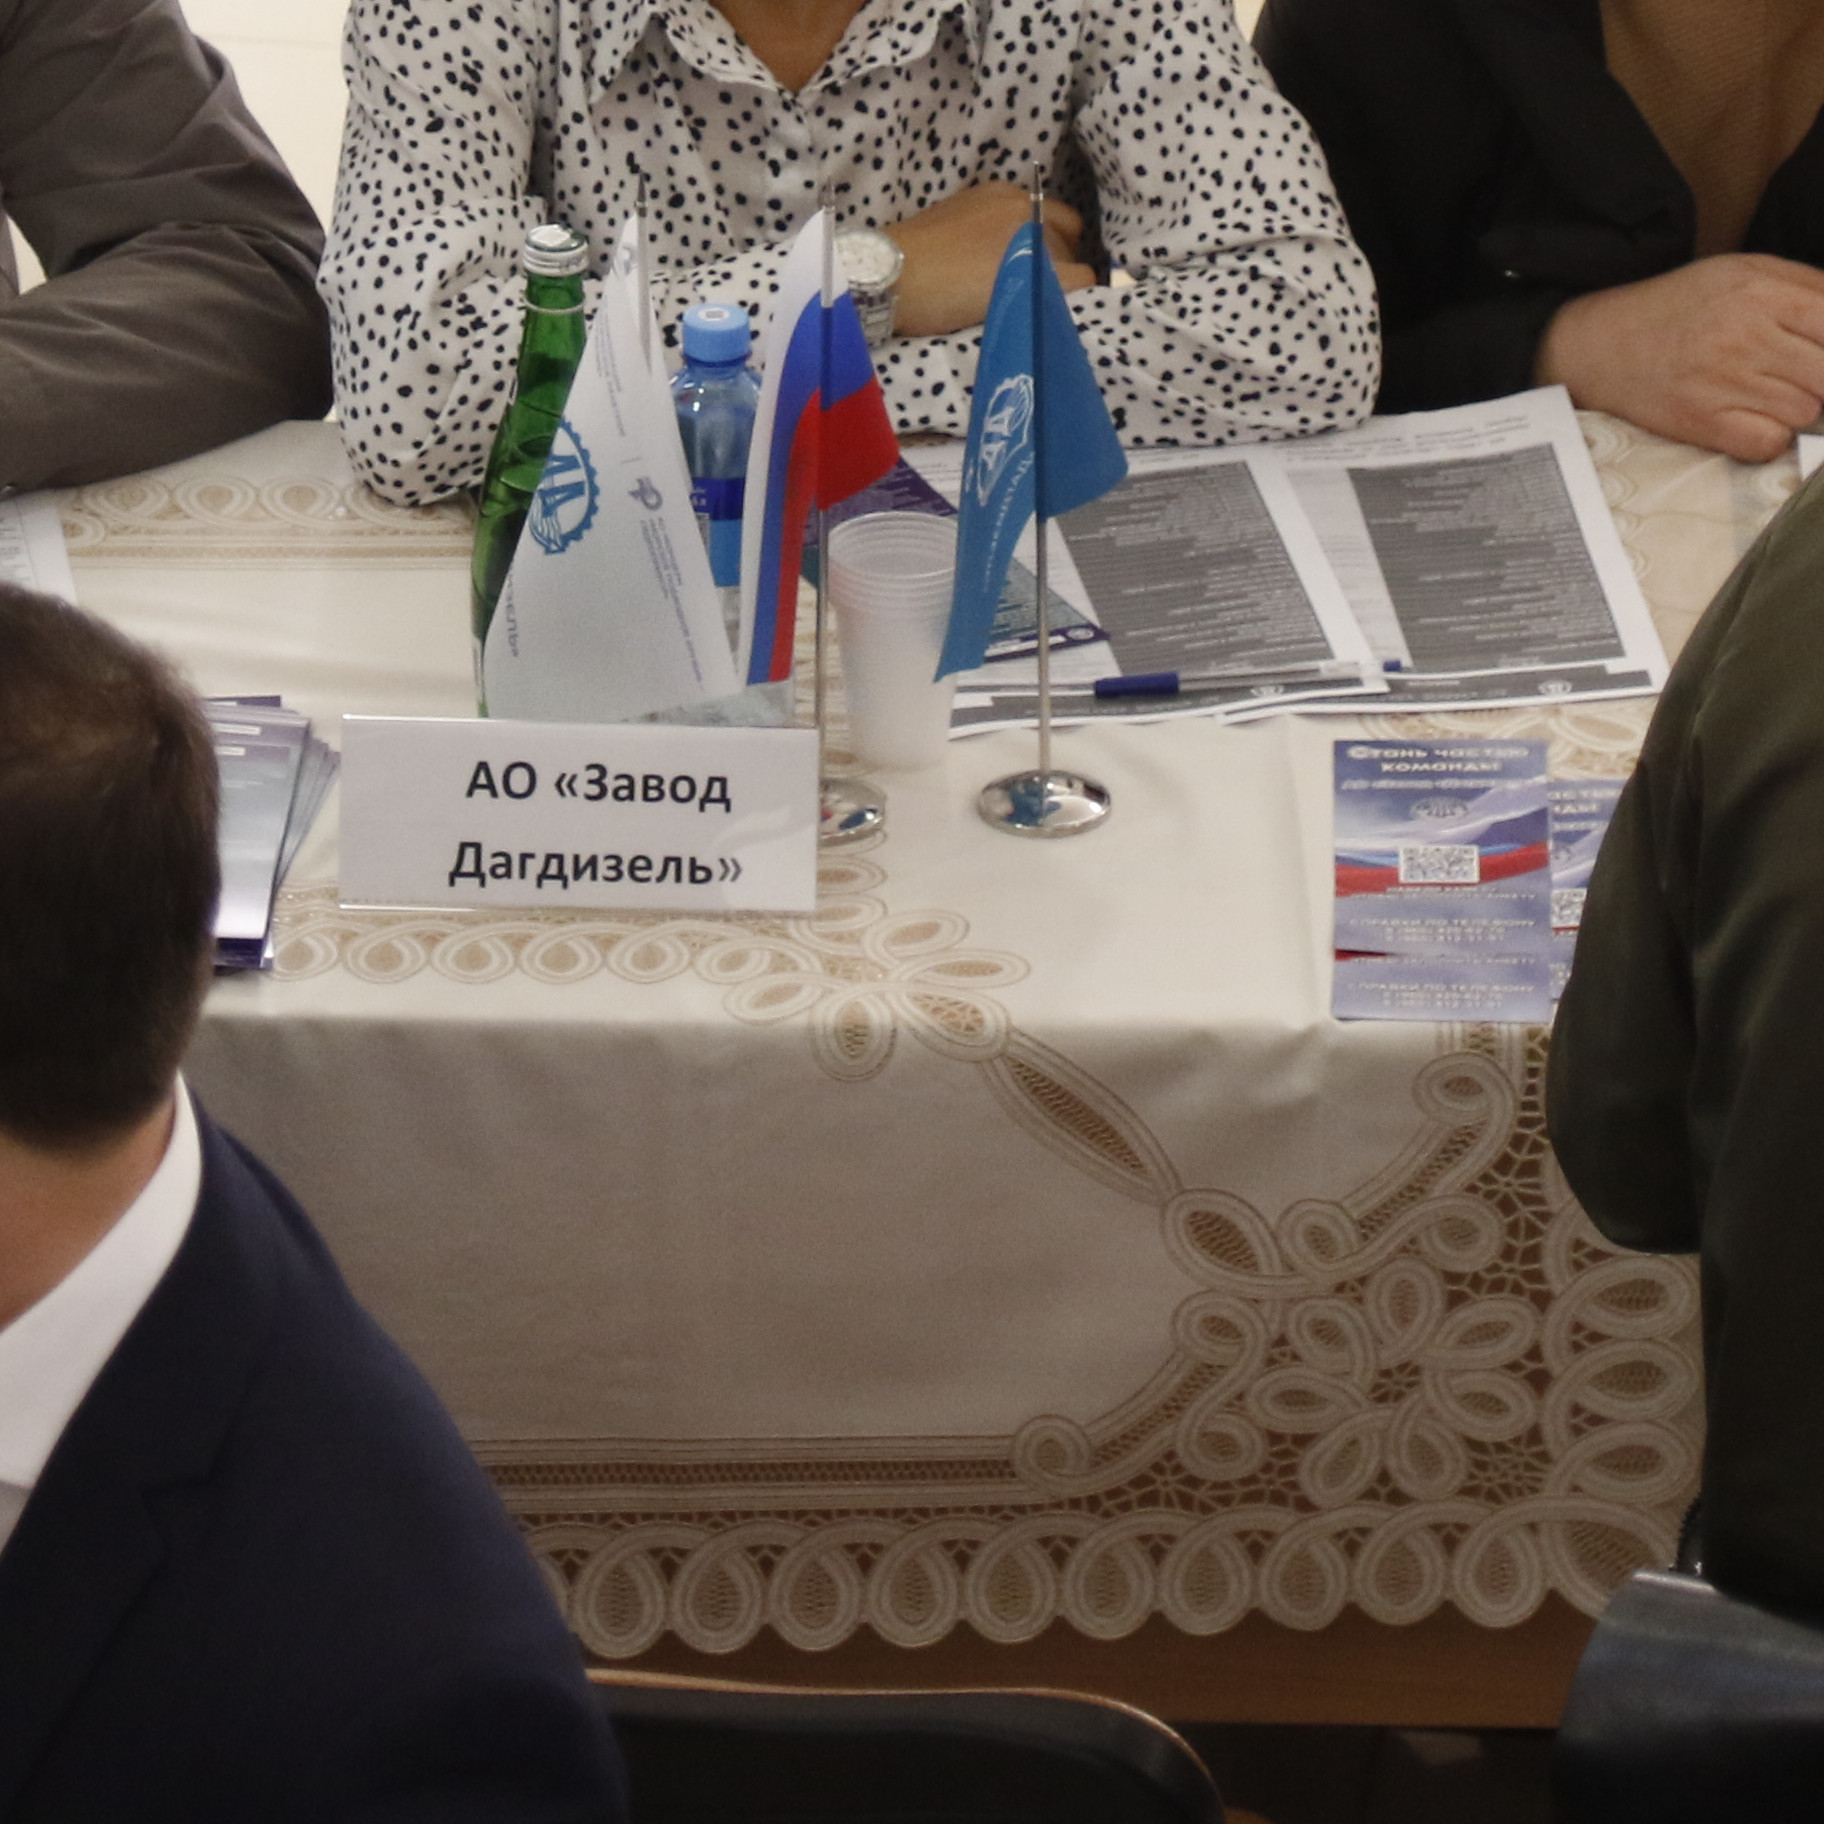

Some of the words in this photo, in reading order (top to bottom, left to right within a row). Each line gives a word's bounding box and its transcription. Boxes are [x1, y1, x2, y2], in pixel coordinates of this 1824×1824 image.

[465, 760, 537, 798] АО
[554, 762, 733, 813] «Завод
[447, 840, 744, 890] Дагдизель»
